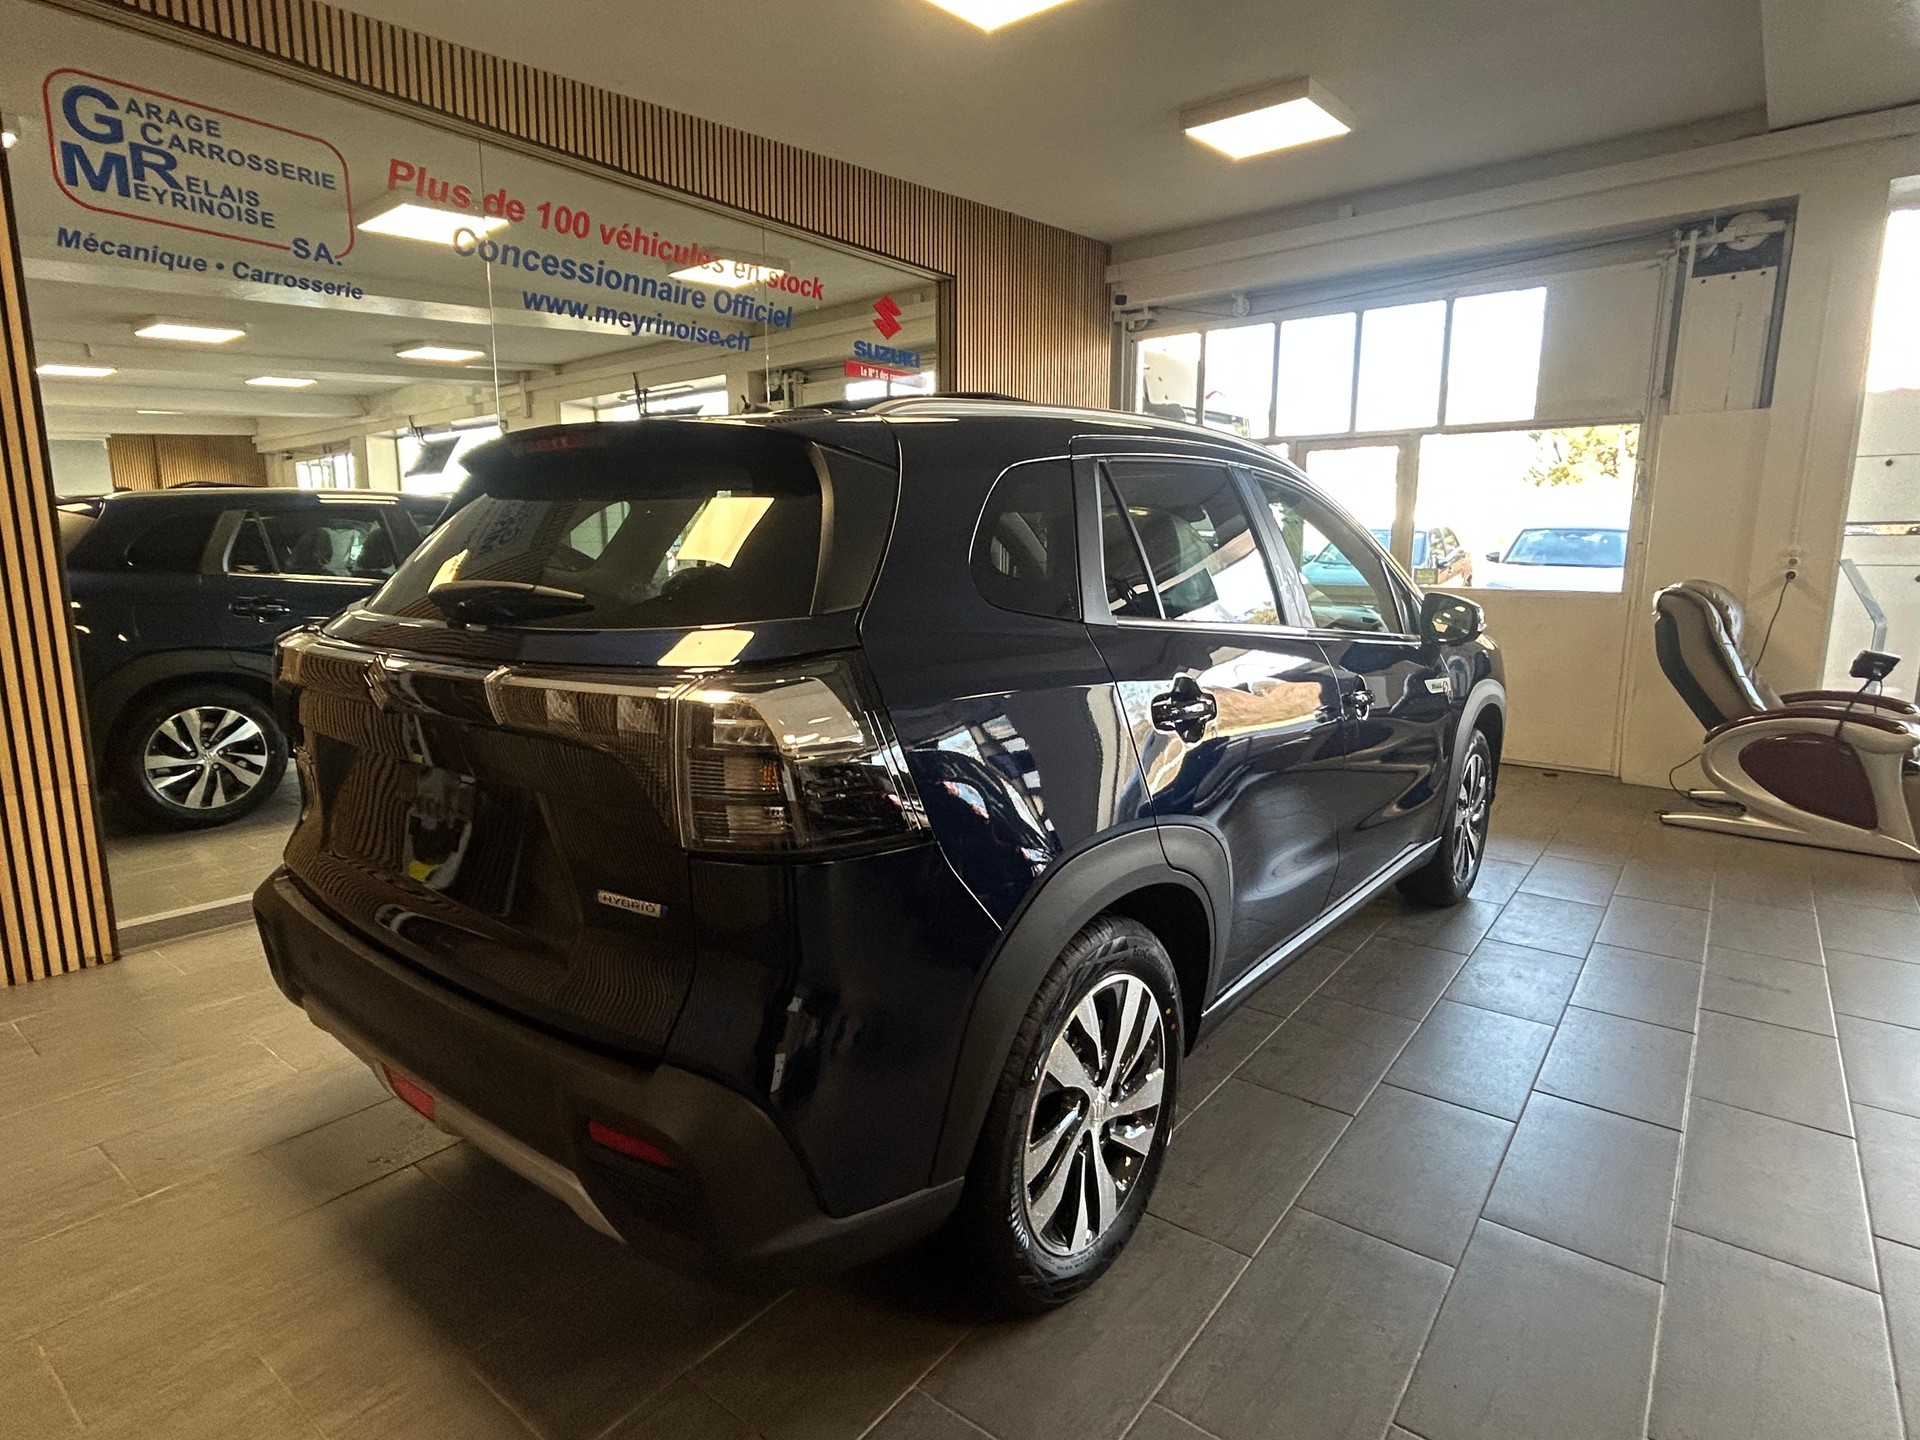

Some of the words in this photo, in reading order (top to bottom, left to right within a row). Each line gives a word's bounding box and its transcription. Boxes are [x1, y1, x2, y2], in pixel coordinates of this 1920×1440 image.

[62, 84, 221, 144] GARAGE
[60, 140, 276, 228] MEYRINOISE
[128, 141, 260, 207] RELAIS
[140, 122, 337, 190] CARROSSERIE
[292, 237, 343, 266] SA.
[387, 158, 472, 208] Plus
[483, 188, 526, 222] de
[537, 201, 591, 239] 100
[600, 222, 725, 275] véhicules
[734, 258, 760, 282] en
[766, 268, 825, 300] stock
[57, 227, 208, 272] Mécanique
[232, 261, 364, 300] Carrosserie
[453, 227, 707, 309] Concessionnaire
[713, 289, 793, 329] Officiel
[522, 291, 751, 352] www.meyrinoise.ch
[853, 340, 921, 368] SUZUKI
[602, 894, 657, 914] HYBRID
